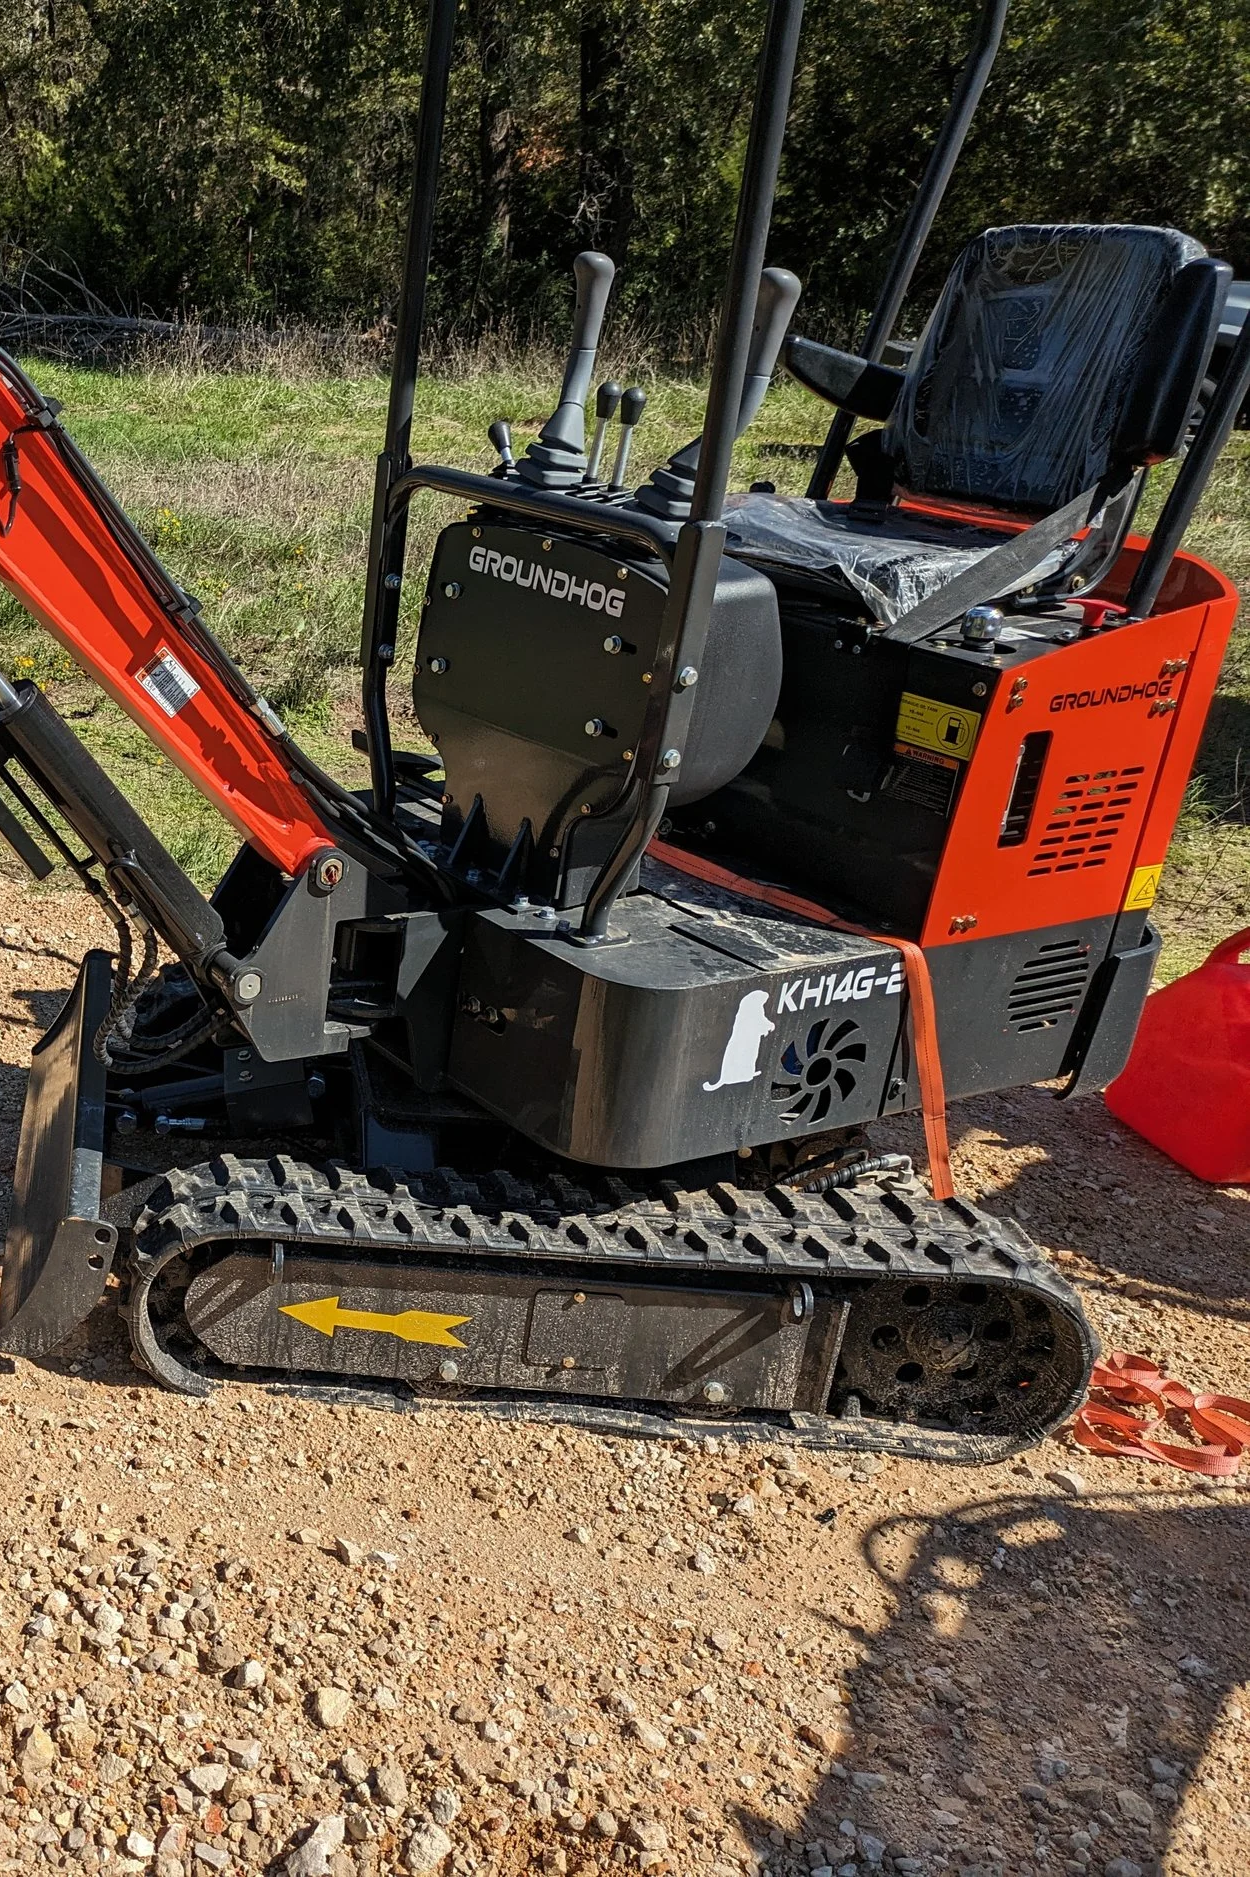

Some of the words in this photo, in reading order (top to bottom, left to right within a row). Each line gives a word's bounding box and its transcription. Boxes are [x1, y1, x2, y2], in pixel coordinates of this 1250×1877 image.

[468, 545, 626, 618] GROUNDHOG
[1049, 680, 1173, 713] GROUNDHOG
[912, 750, 945, 765] WARNING
[777, 962, 906, 1014] KH14G-2
